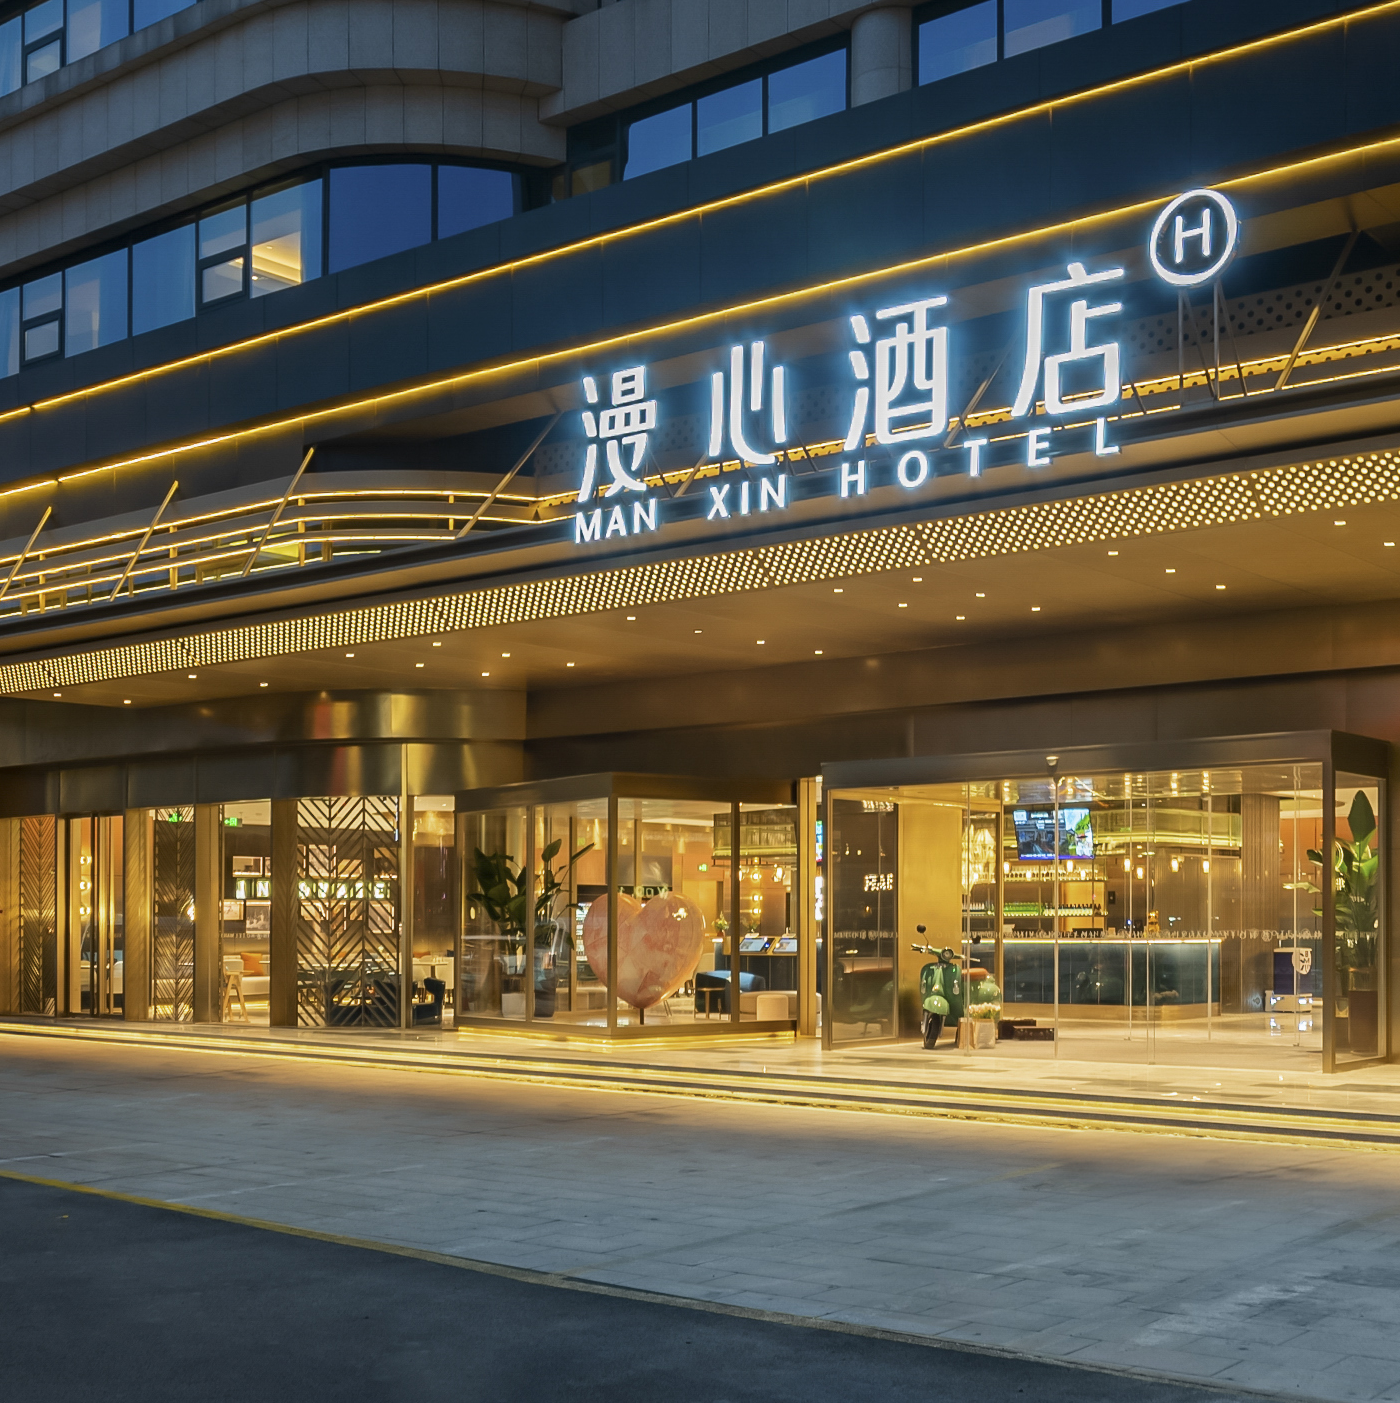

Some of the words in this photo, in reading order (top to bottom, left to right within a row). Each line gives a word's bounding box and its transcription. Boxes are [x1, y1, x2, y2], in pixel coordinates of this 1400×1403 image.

[578, 262, 1125, 503] 漫心酒店
[573, 498, 657, 544] MAN
[707, 473, 788, 520] XIN
[840, 416, 1120, 498] HOTEL
